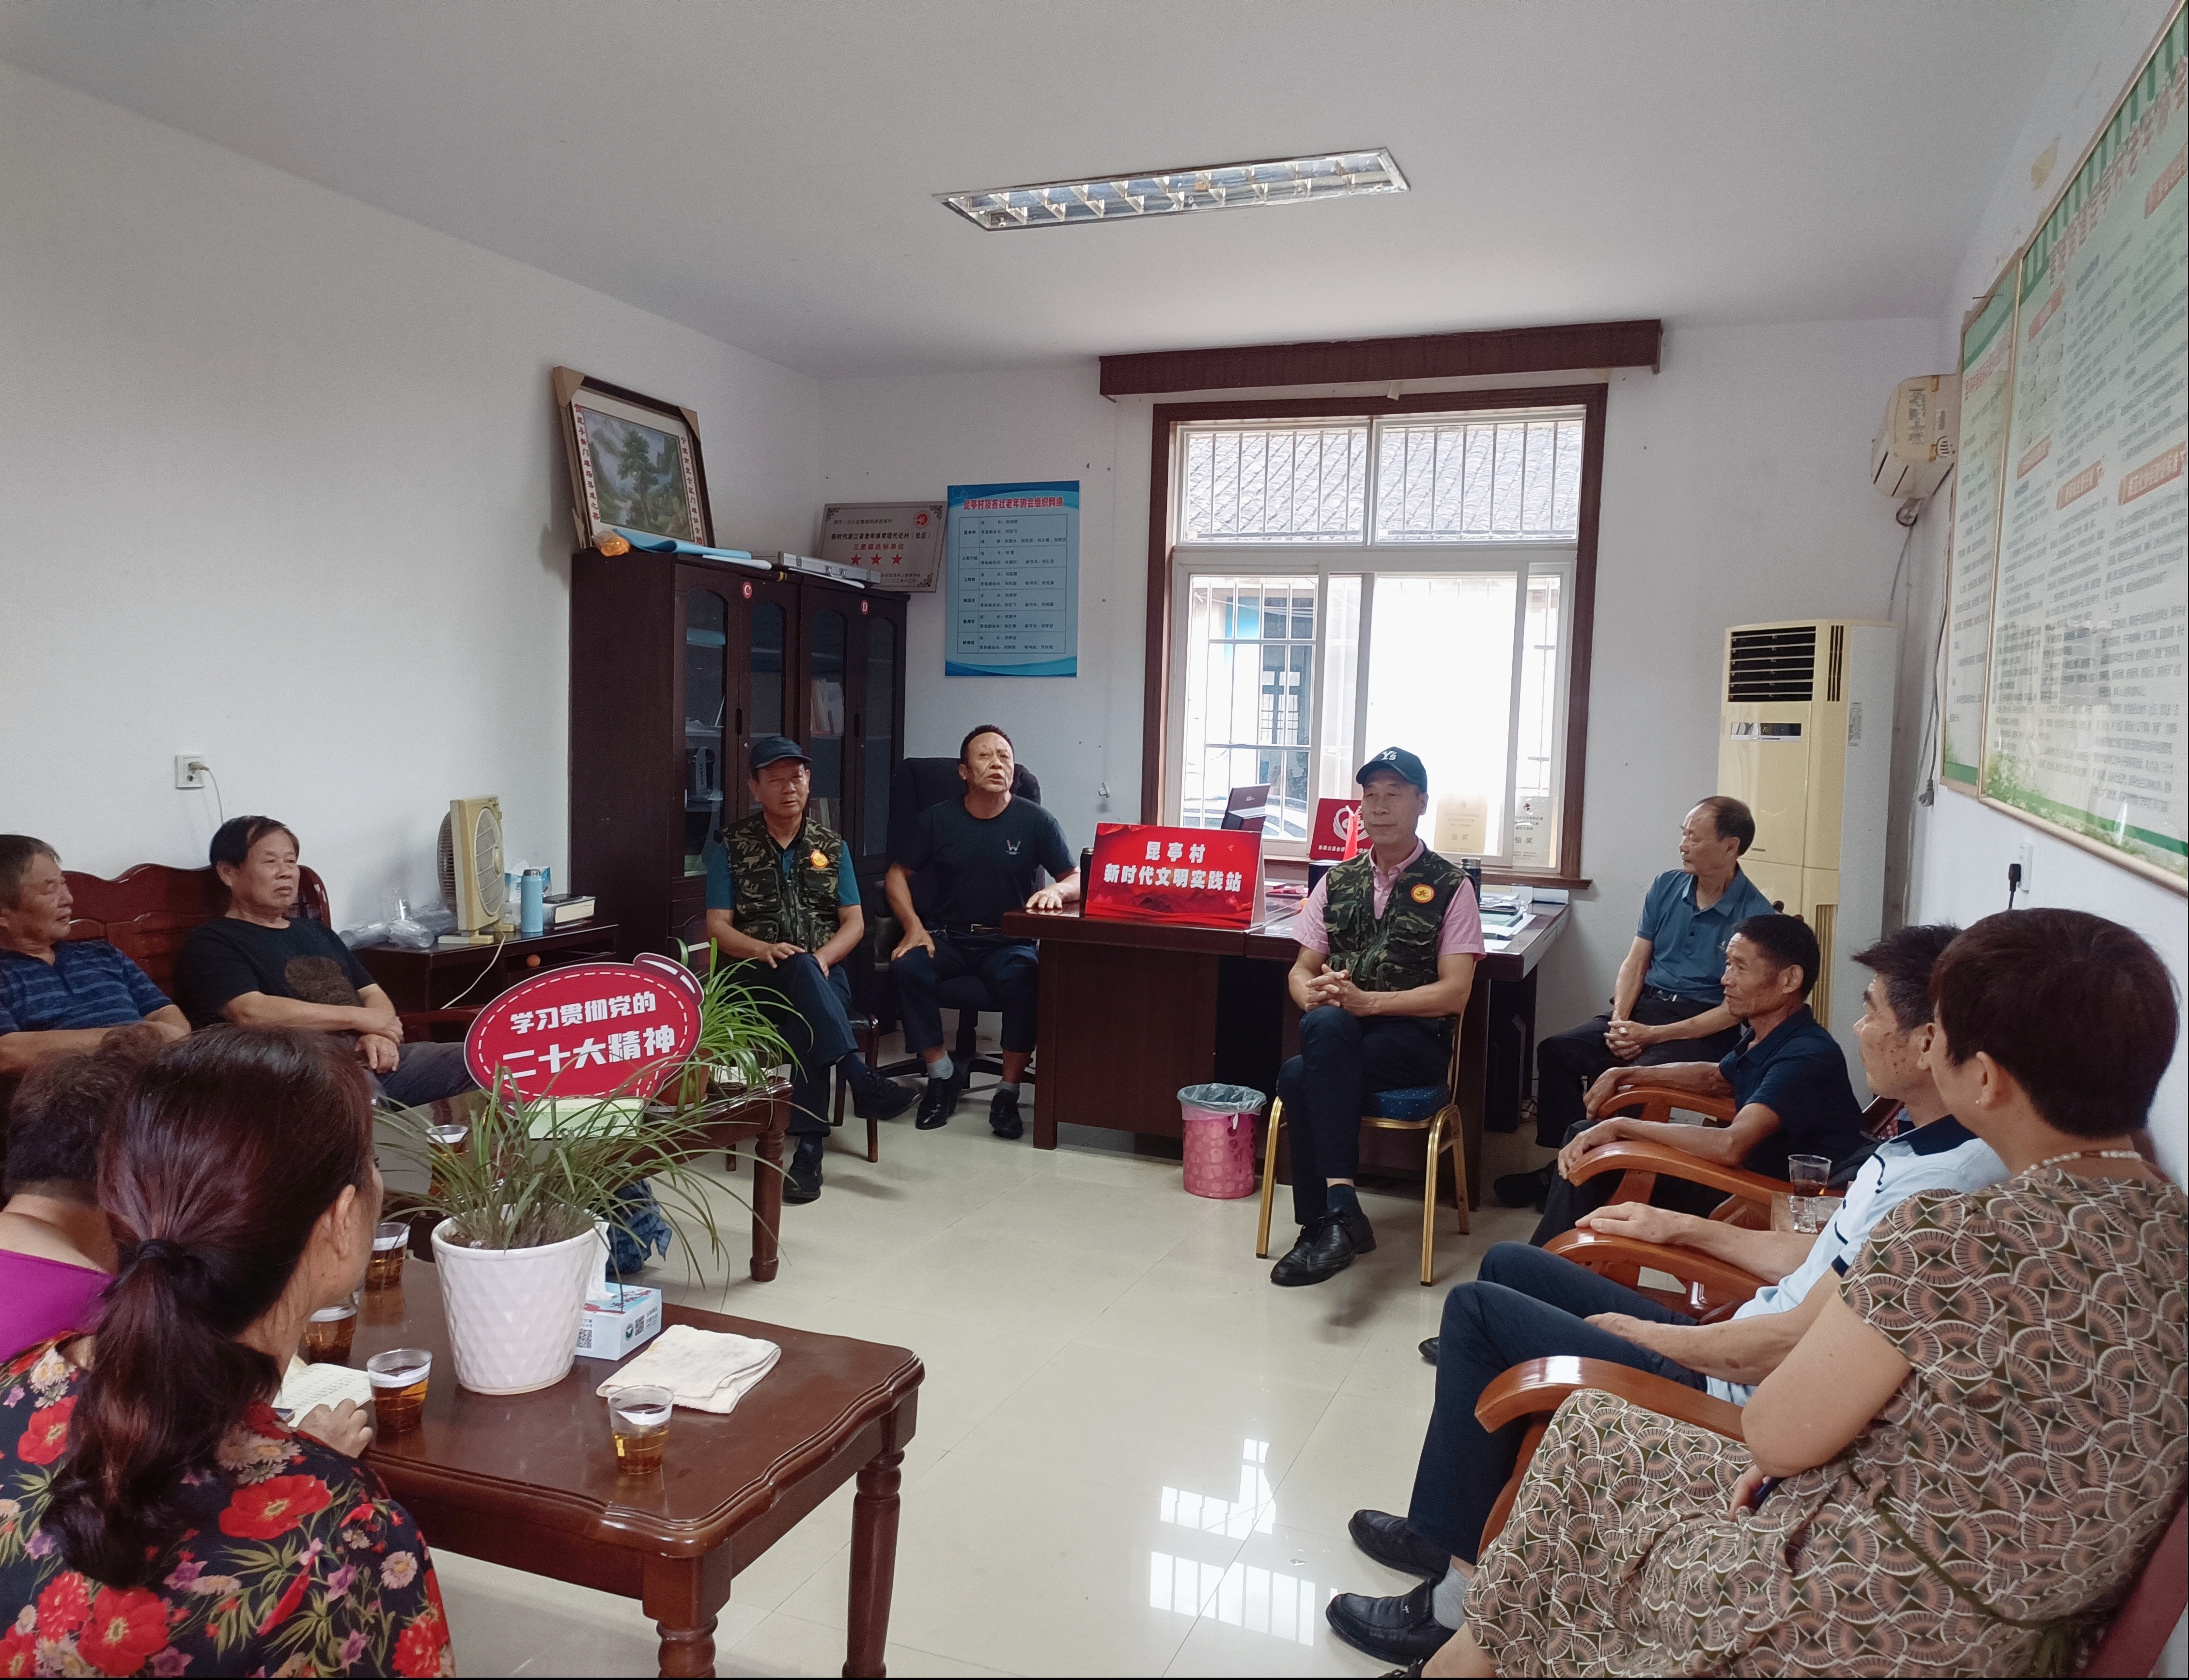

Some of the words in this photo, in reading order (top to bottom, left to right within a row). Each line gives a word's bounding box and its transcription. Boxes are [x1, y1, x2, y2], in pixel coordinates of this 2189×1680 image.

[744, 584, 751, 595] C
[863, 602, 868, 612] D
[1145, 841, 1206, 864] 昆亭村
[1103, 863, 1242, 892] 新时代文明实践站
[510, 991, 656, 1035] 学习贯彻党的
[502, 1025, 676, 1080] 二十大精神
